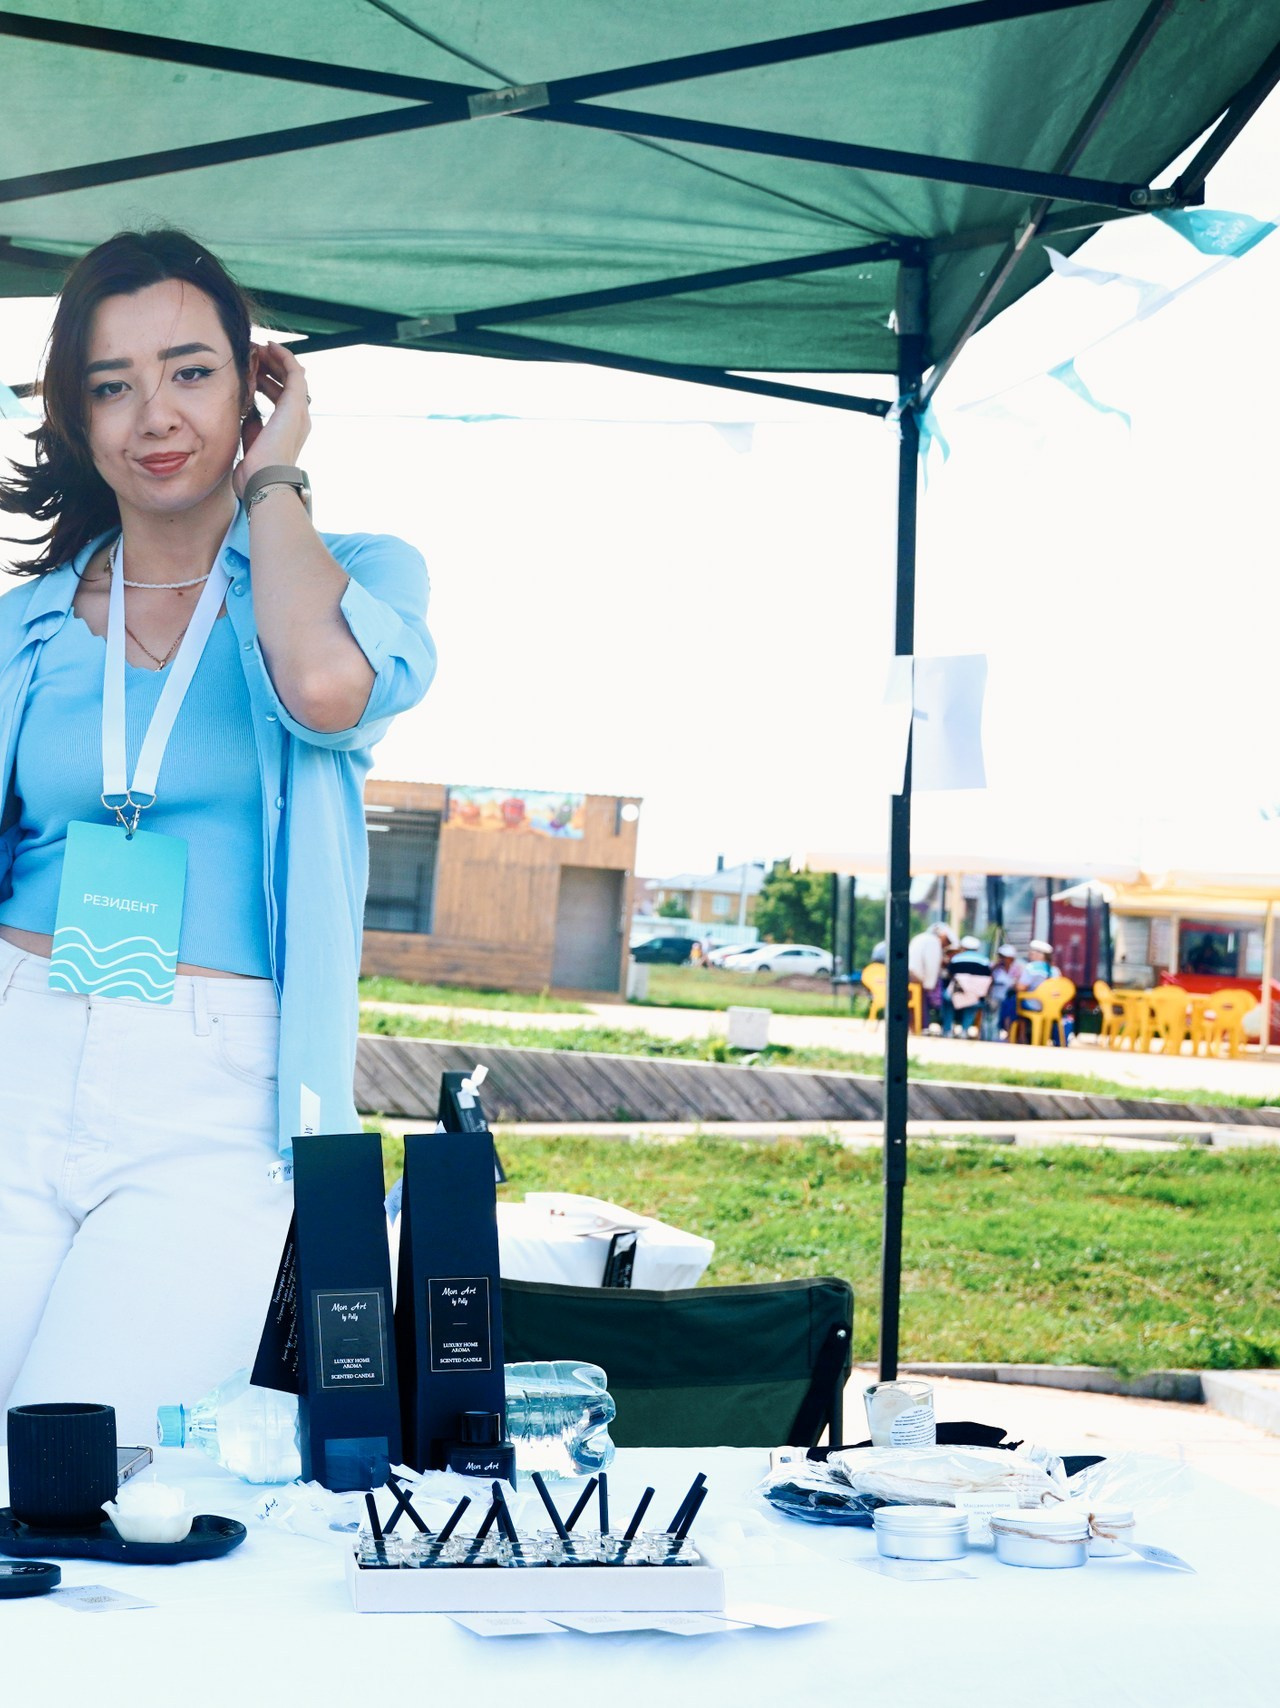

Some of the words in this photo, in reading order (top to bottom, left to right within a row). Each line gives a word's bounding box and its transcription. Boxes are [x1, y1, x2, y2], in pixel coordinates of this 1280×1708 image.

[83, 893, 159, 914] РЕЗИДЕНТ
[442, 1288, 458, 1296] Mon
[461, 1286, 476, 1296] Art
[331, 1303, 348, 1312] Mon
[350, 1302, 367, 1310] Art
[466, 1462, 481, 1470] Mon
[484, 1461, 499, 1470] Art
